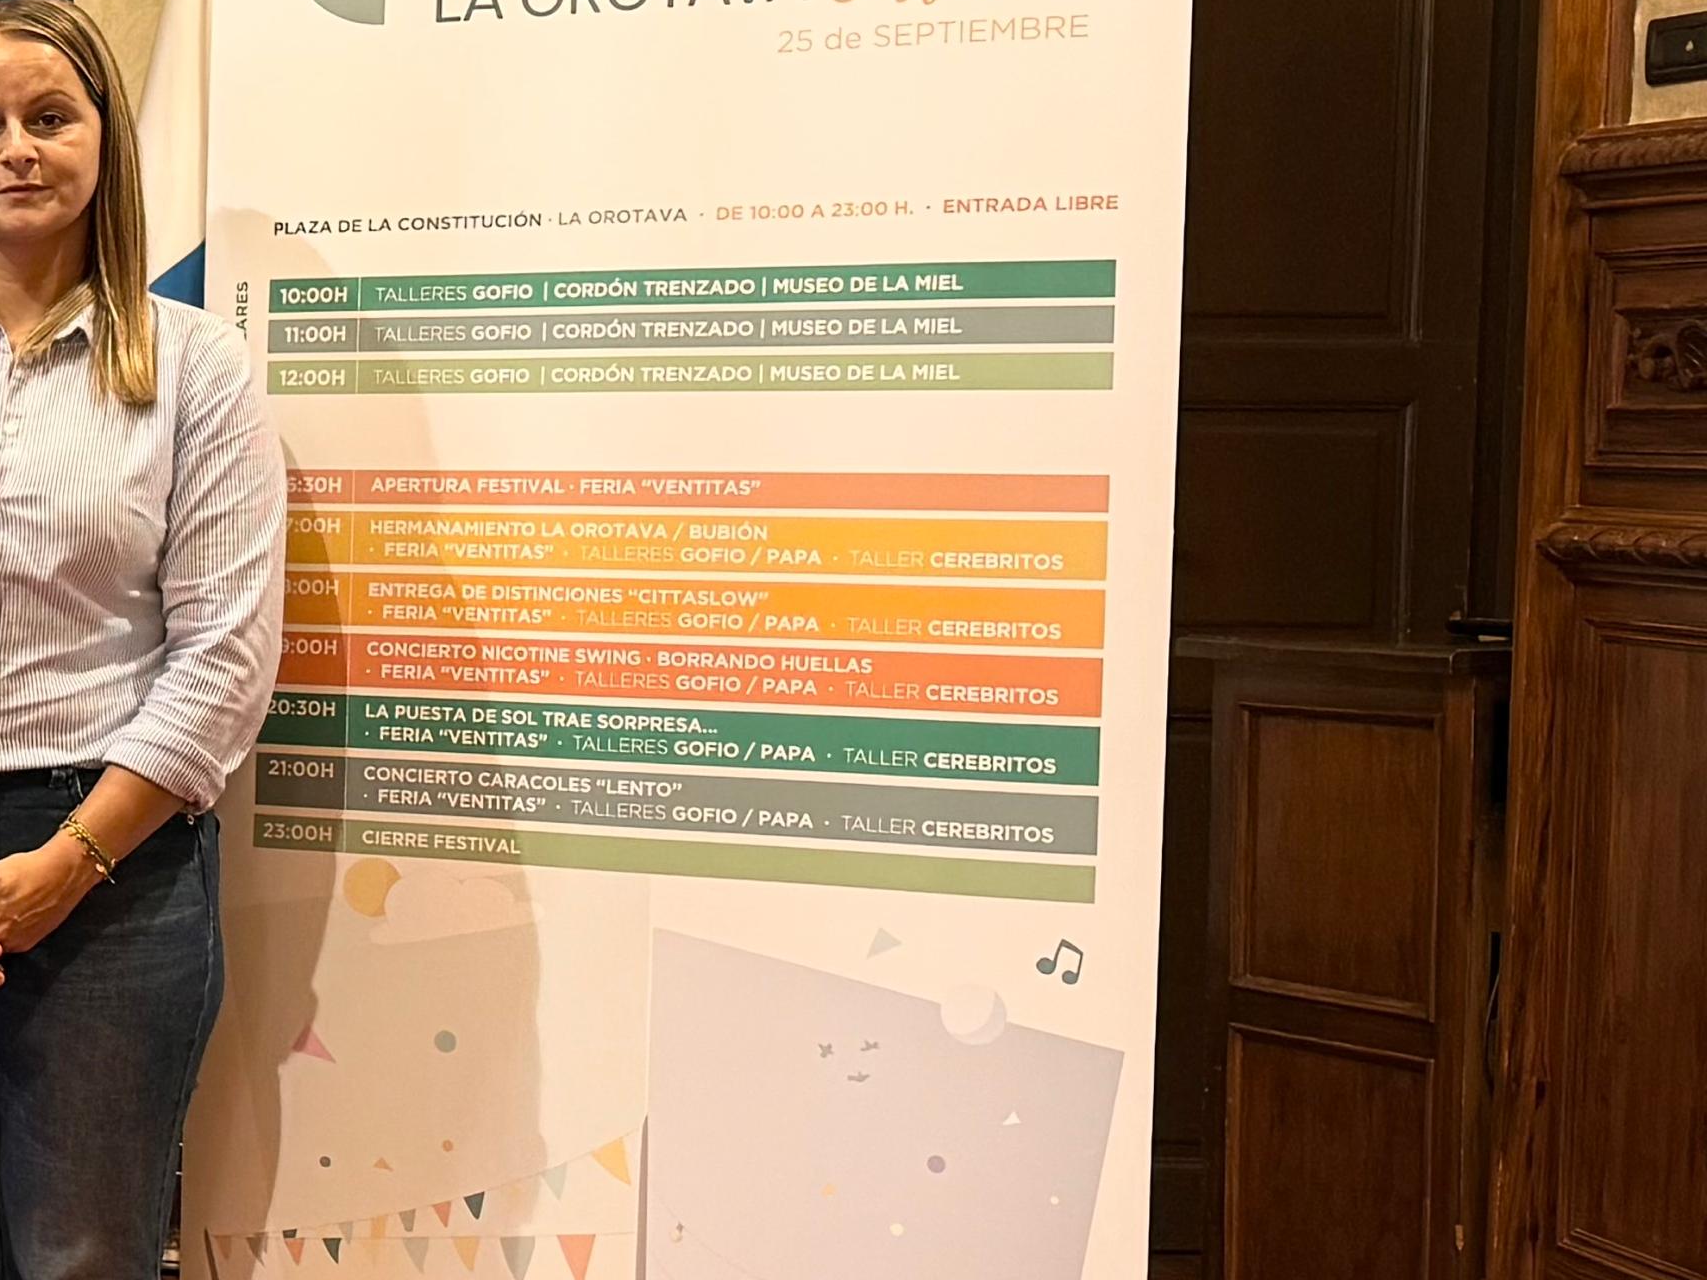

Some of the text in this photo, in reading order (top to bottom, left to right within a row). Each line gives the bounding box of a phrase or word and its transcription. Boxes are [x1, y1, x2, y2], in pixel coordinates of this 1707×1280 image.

[777, 13, 1089, 54] 25 de SEPTIEMBRE
[273, 194, 1119, 237] PLAZA DE LA CONSTITUCIÓN LA OROTAVA DE 10:00 A 23:00 H. ENTRADA LIBRE
[279, 273, 964, 304] 10:00H TALLERES GOFIO CORDÓN TRENZADO MUSEO DE LA MIEL
[286, 477, 342, 493] 6:30H
[370, 477, 472, 493] APERTURA
[477, 478, 565, 494] FESTIVAL
[580, 478, 636, 495] FERIA
[285, 517, 768, 541] 7:00H HERMANAMIENTO LA OROTAVA BUBIÓN
[384, 541, 439, 558] FERIA
[582, 546, 674, 562] TALLERES
[680, 547, 746, 564] GOFIO
[766, 548, 822, 565] PAPA
[851, 550, 923, 567] TALLER
[929, 551, 1064, 571] CEREBRITOS
[267, 698, 718, 734] 20:30H LA PUESTA DE SOL TRAE SORPRESA...
[379, 726, 434, 743] FERIA
[573, 735, 668, 755] TALLERES
[673, 740, 740, 758] GOFIO
[760, 743, 816, 762] PAPA
[843, 747, 918, 768] TALLER
[923, 752, 1056, 774] CEREBRITOS
[263, 822, 521, 854] 23:00H CIERRE FESTIVAL
